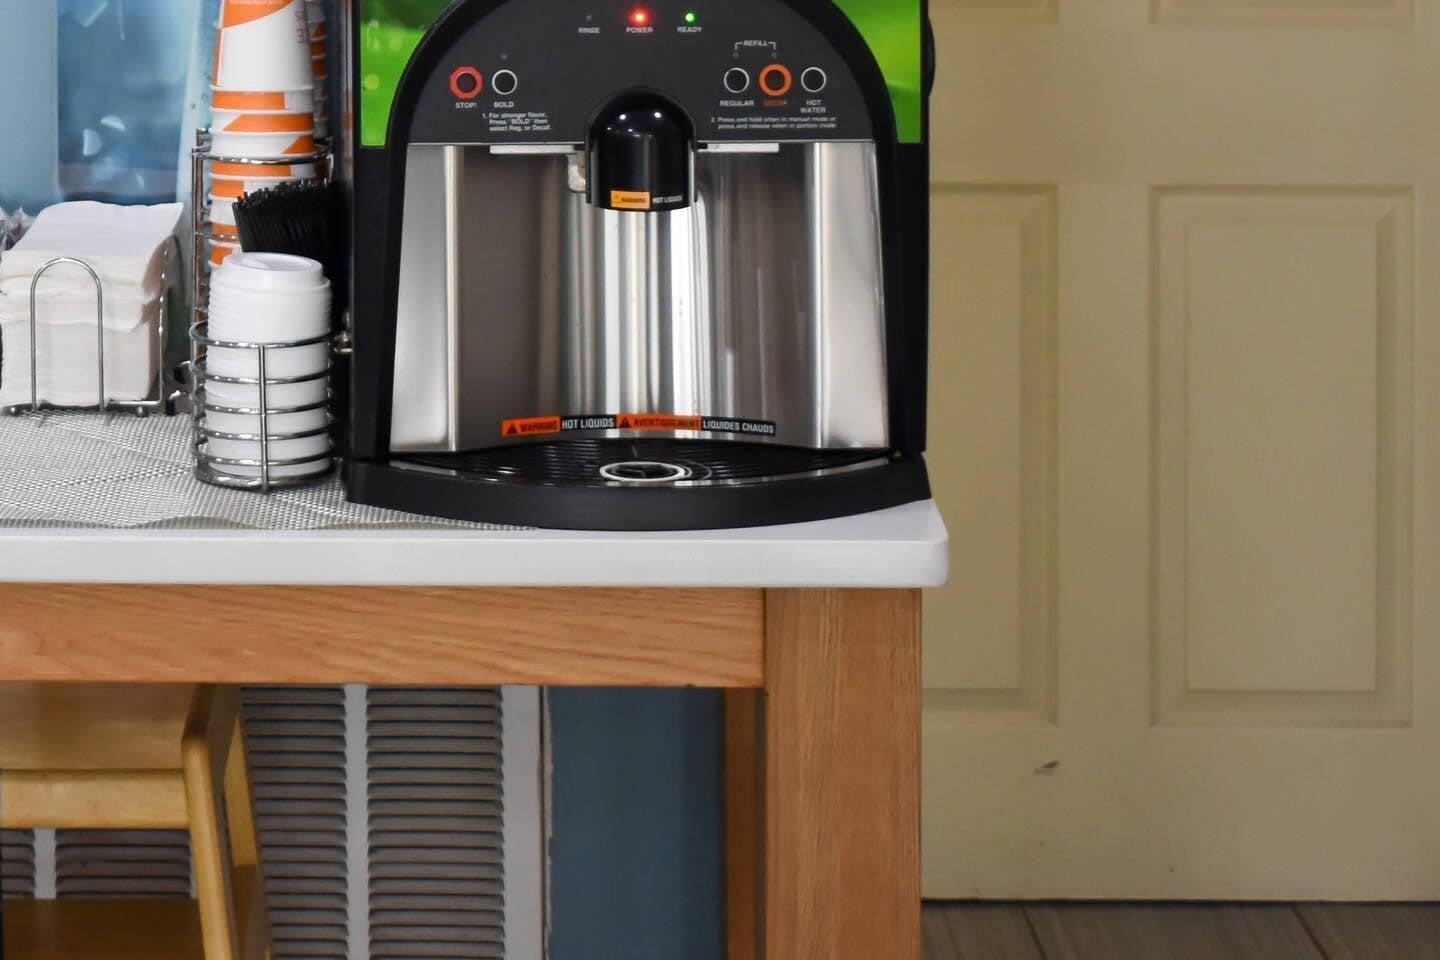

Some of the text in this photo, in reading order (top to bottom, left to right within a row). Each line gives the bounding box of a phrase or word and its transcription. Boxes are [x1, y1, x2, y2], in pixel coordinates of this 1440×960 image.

[677, 25, 702, 33] READY
[561, 419, 578, 429] HOT
[580, 418, 615, 428] LIQUIDS
[702, 419, 740, 431] LIQUIDES
[741, 422, 774, 434] CHAUDS
